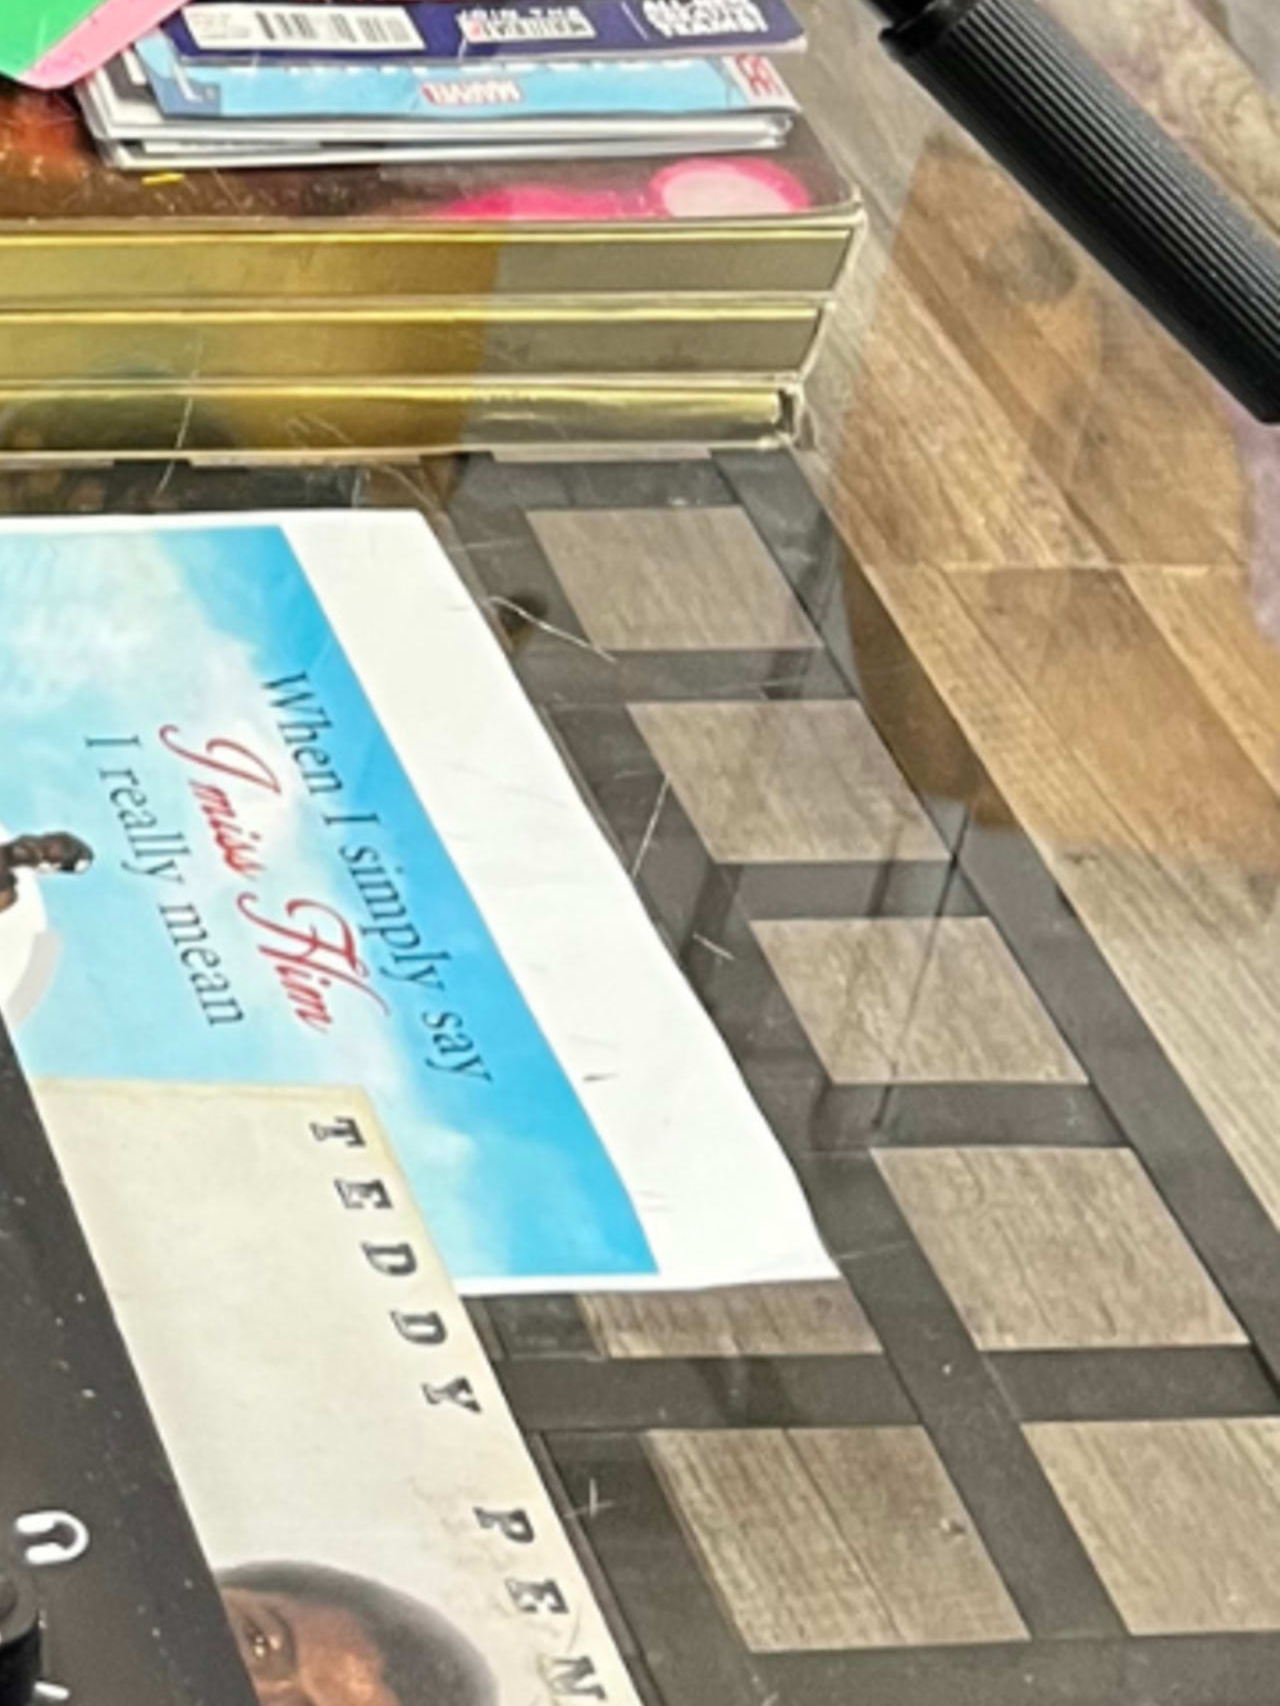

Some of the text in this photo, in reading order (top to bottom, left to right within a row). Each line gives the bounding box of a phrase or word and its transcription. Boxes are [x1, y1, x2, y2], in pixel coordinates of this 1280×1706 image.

[85, 735, 245, 1027] I really mean
[159, 724, 392, 1034] I miss Him
[262, 671, 494, 1085] When I simply say
[310, 1116, 482, 1417] TEDDY
